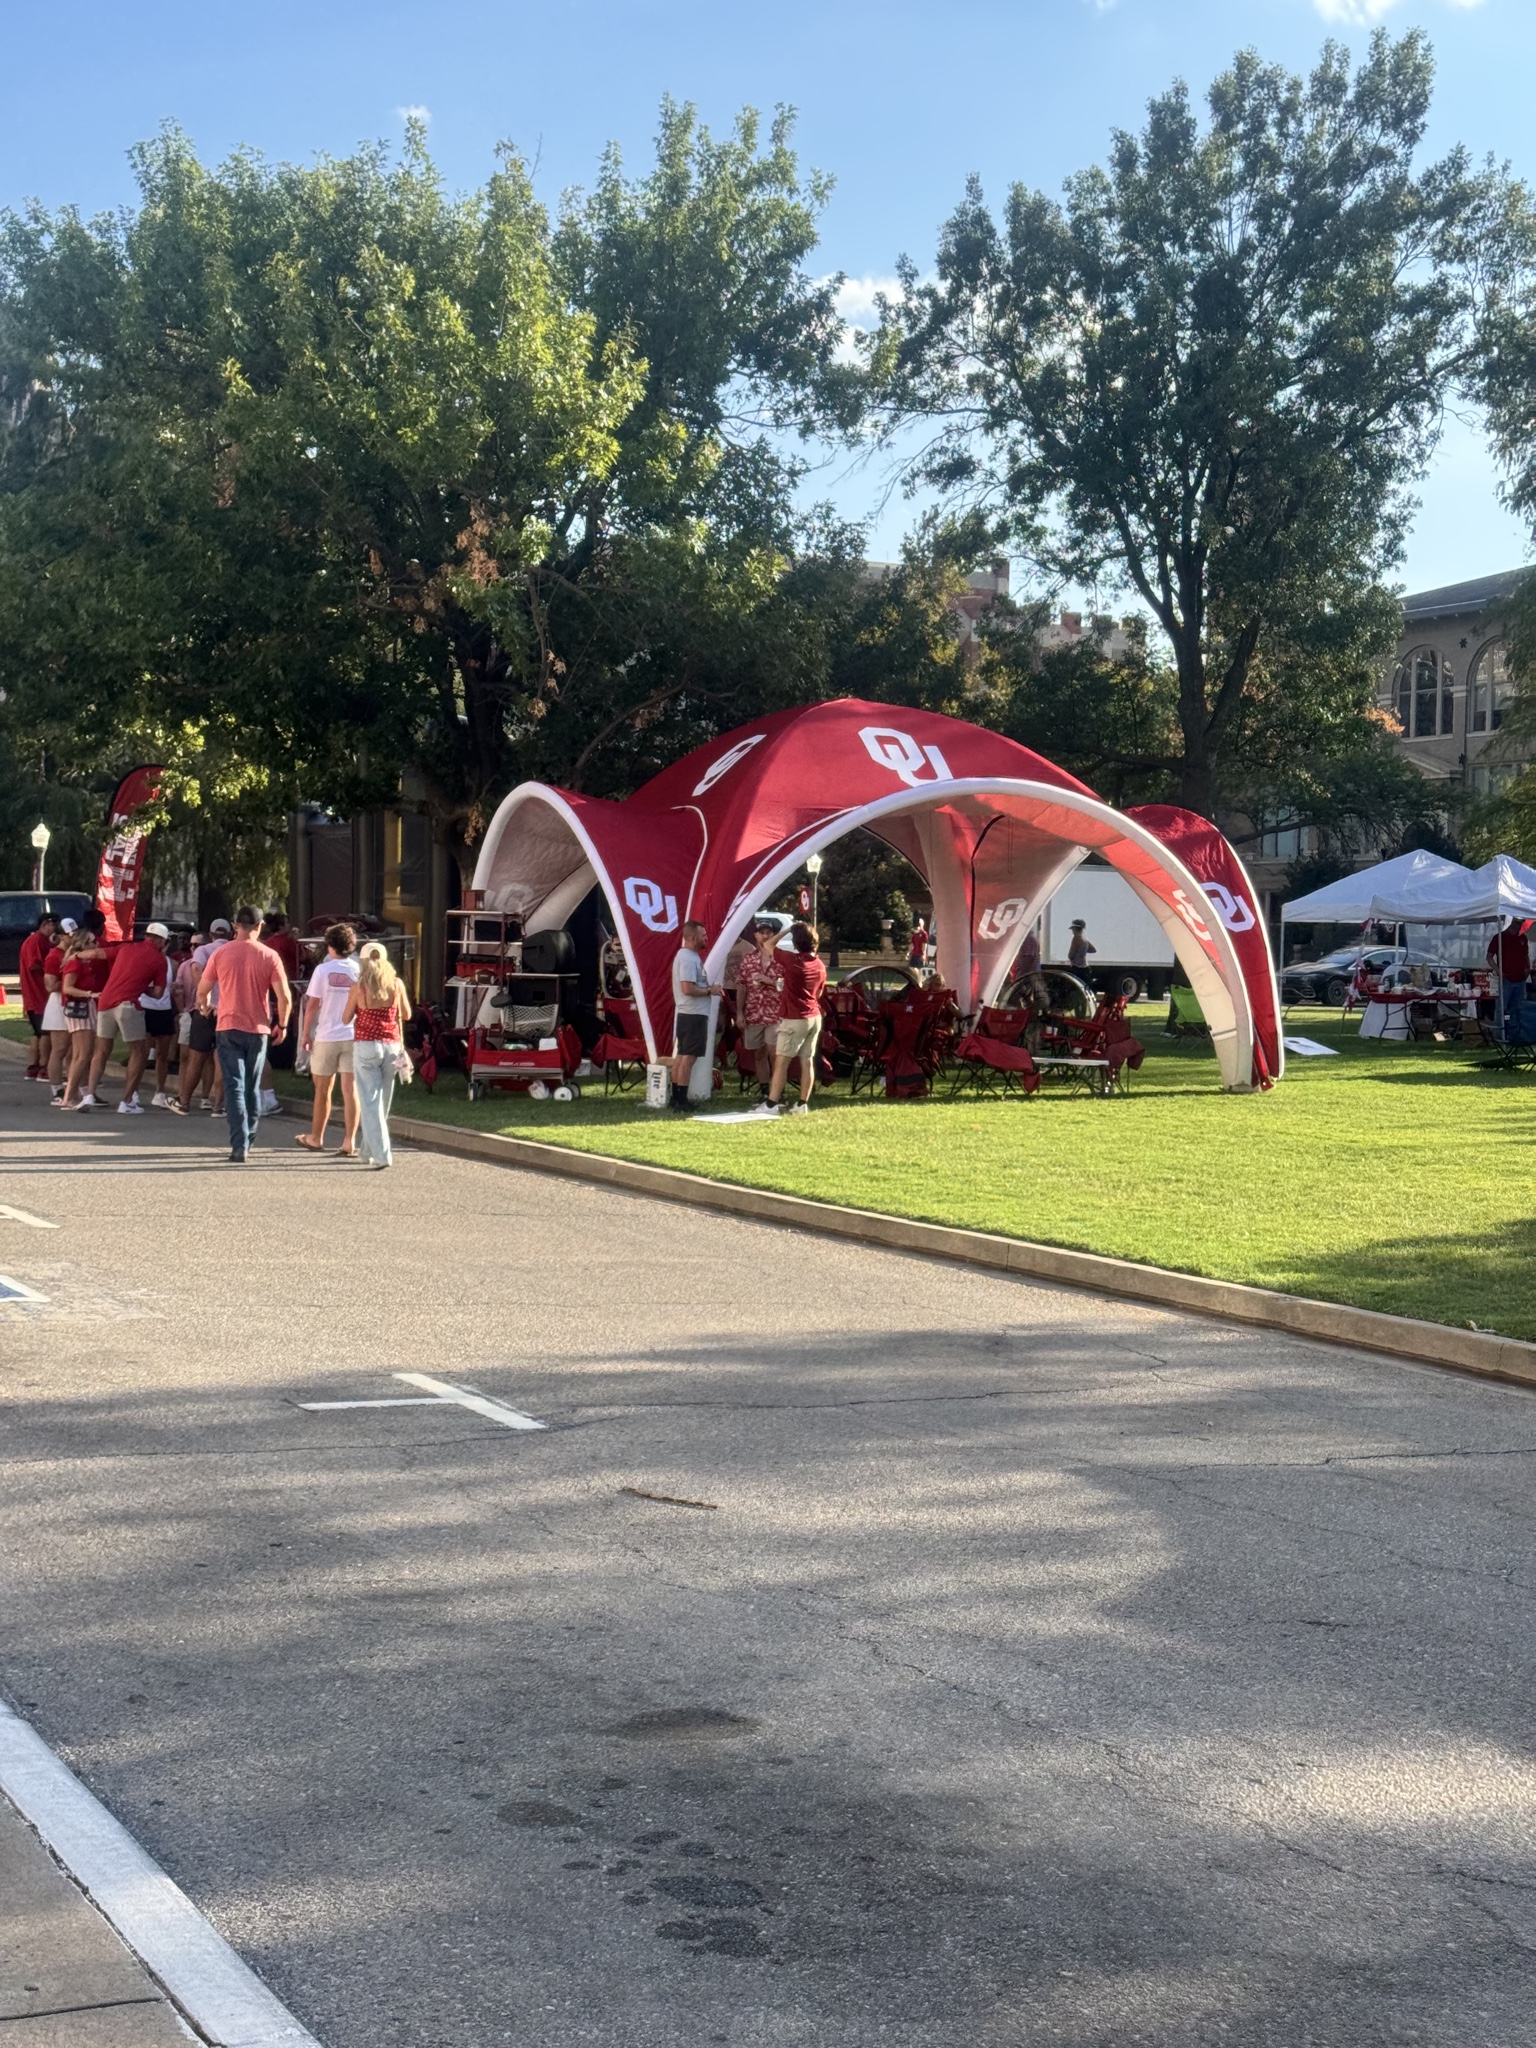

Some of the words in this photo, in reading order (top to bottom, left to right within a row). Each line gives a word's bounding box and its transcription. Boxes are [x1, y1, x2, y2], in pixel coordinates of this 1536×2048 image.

[858, 726, 954, 788] OU
[623, 876, 679, 933] OU
[1199, 882, 1256, 932] OU
